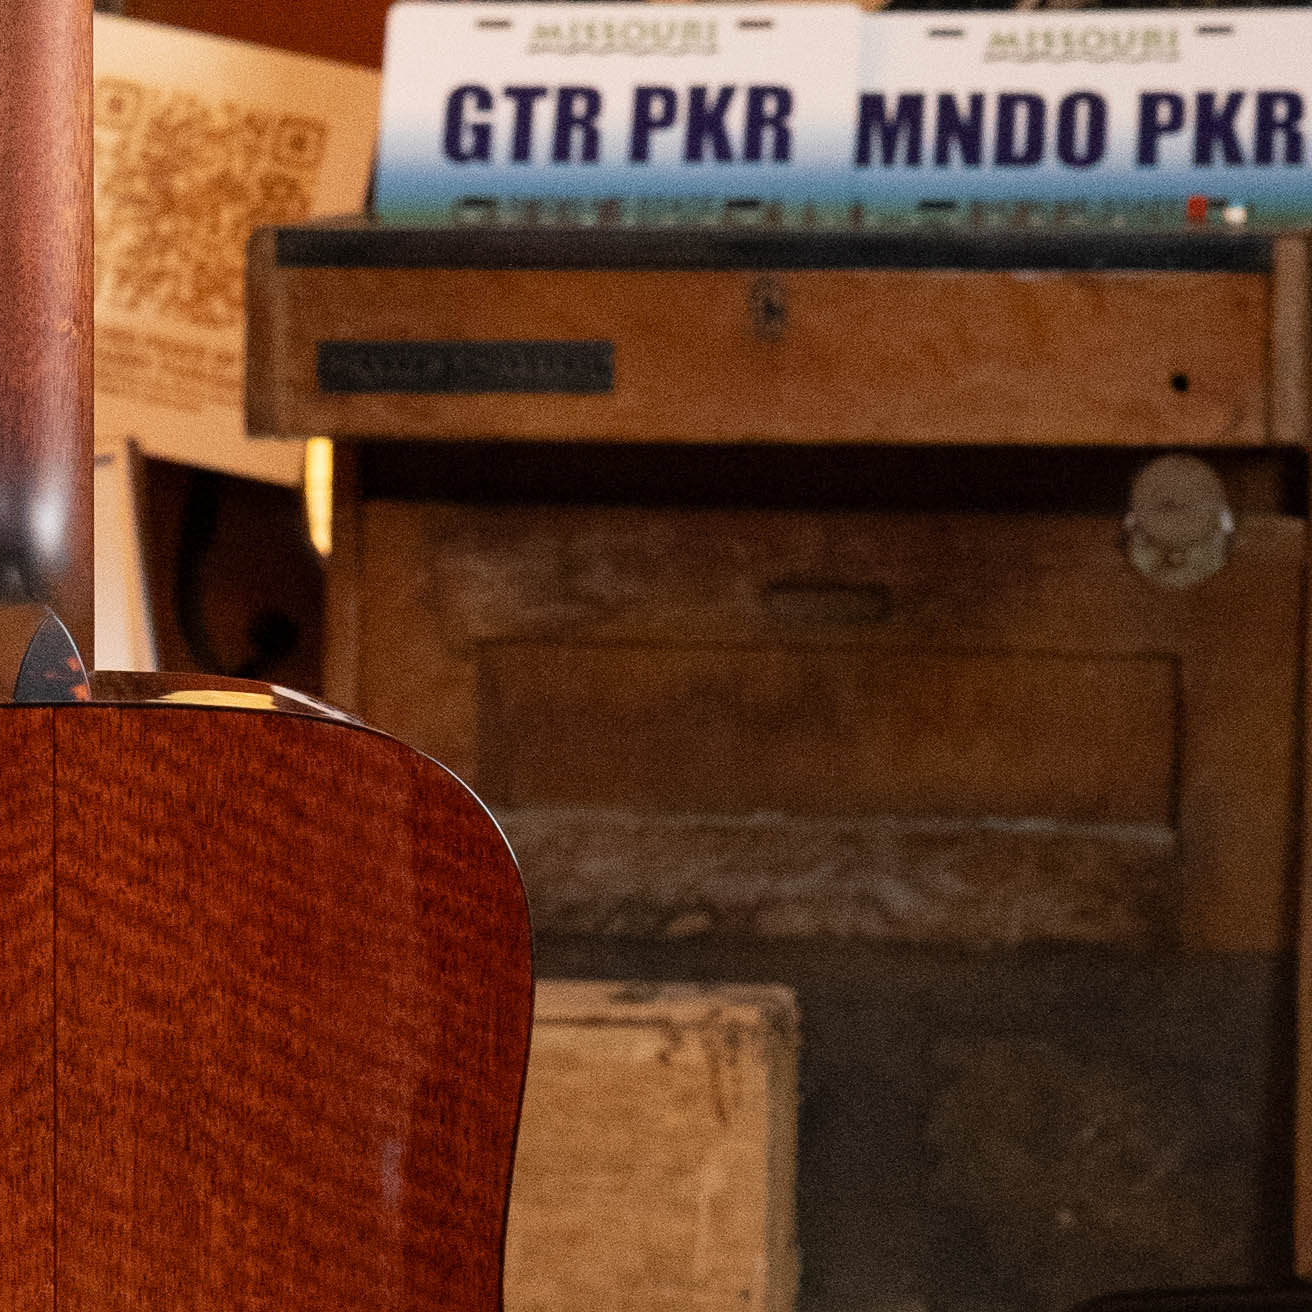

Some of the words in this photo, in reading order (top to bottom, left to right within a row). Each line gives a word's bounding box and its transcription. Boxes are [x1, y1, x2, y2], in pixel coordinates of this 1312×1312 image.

[442, 83, 604, 165] GTR
[628, 83, 795, 164] PKR
[854, 90, 1109, 168] MNDO
[1135, 90, 1305, 167] PKR
